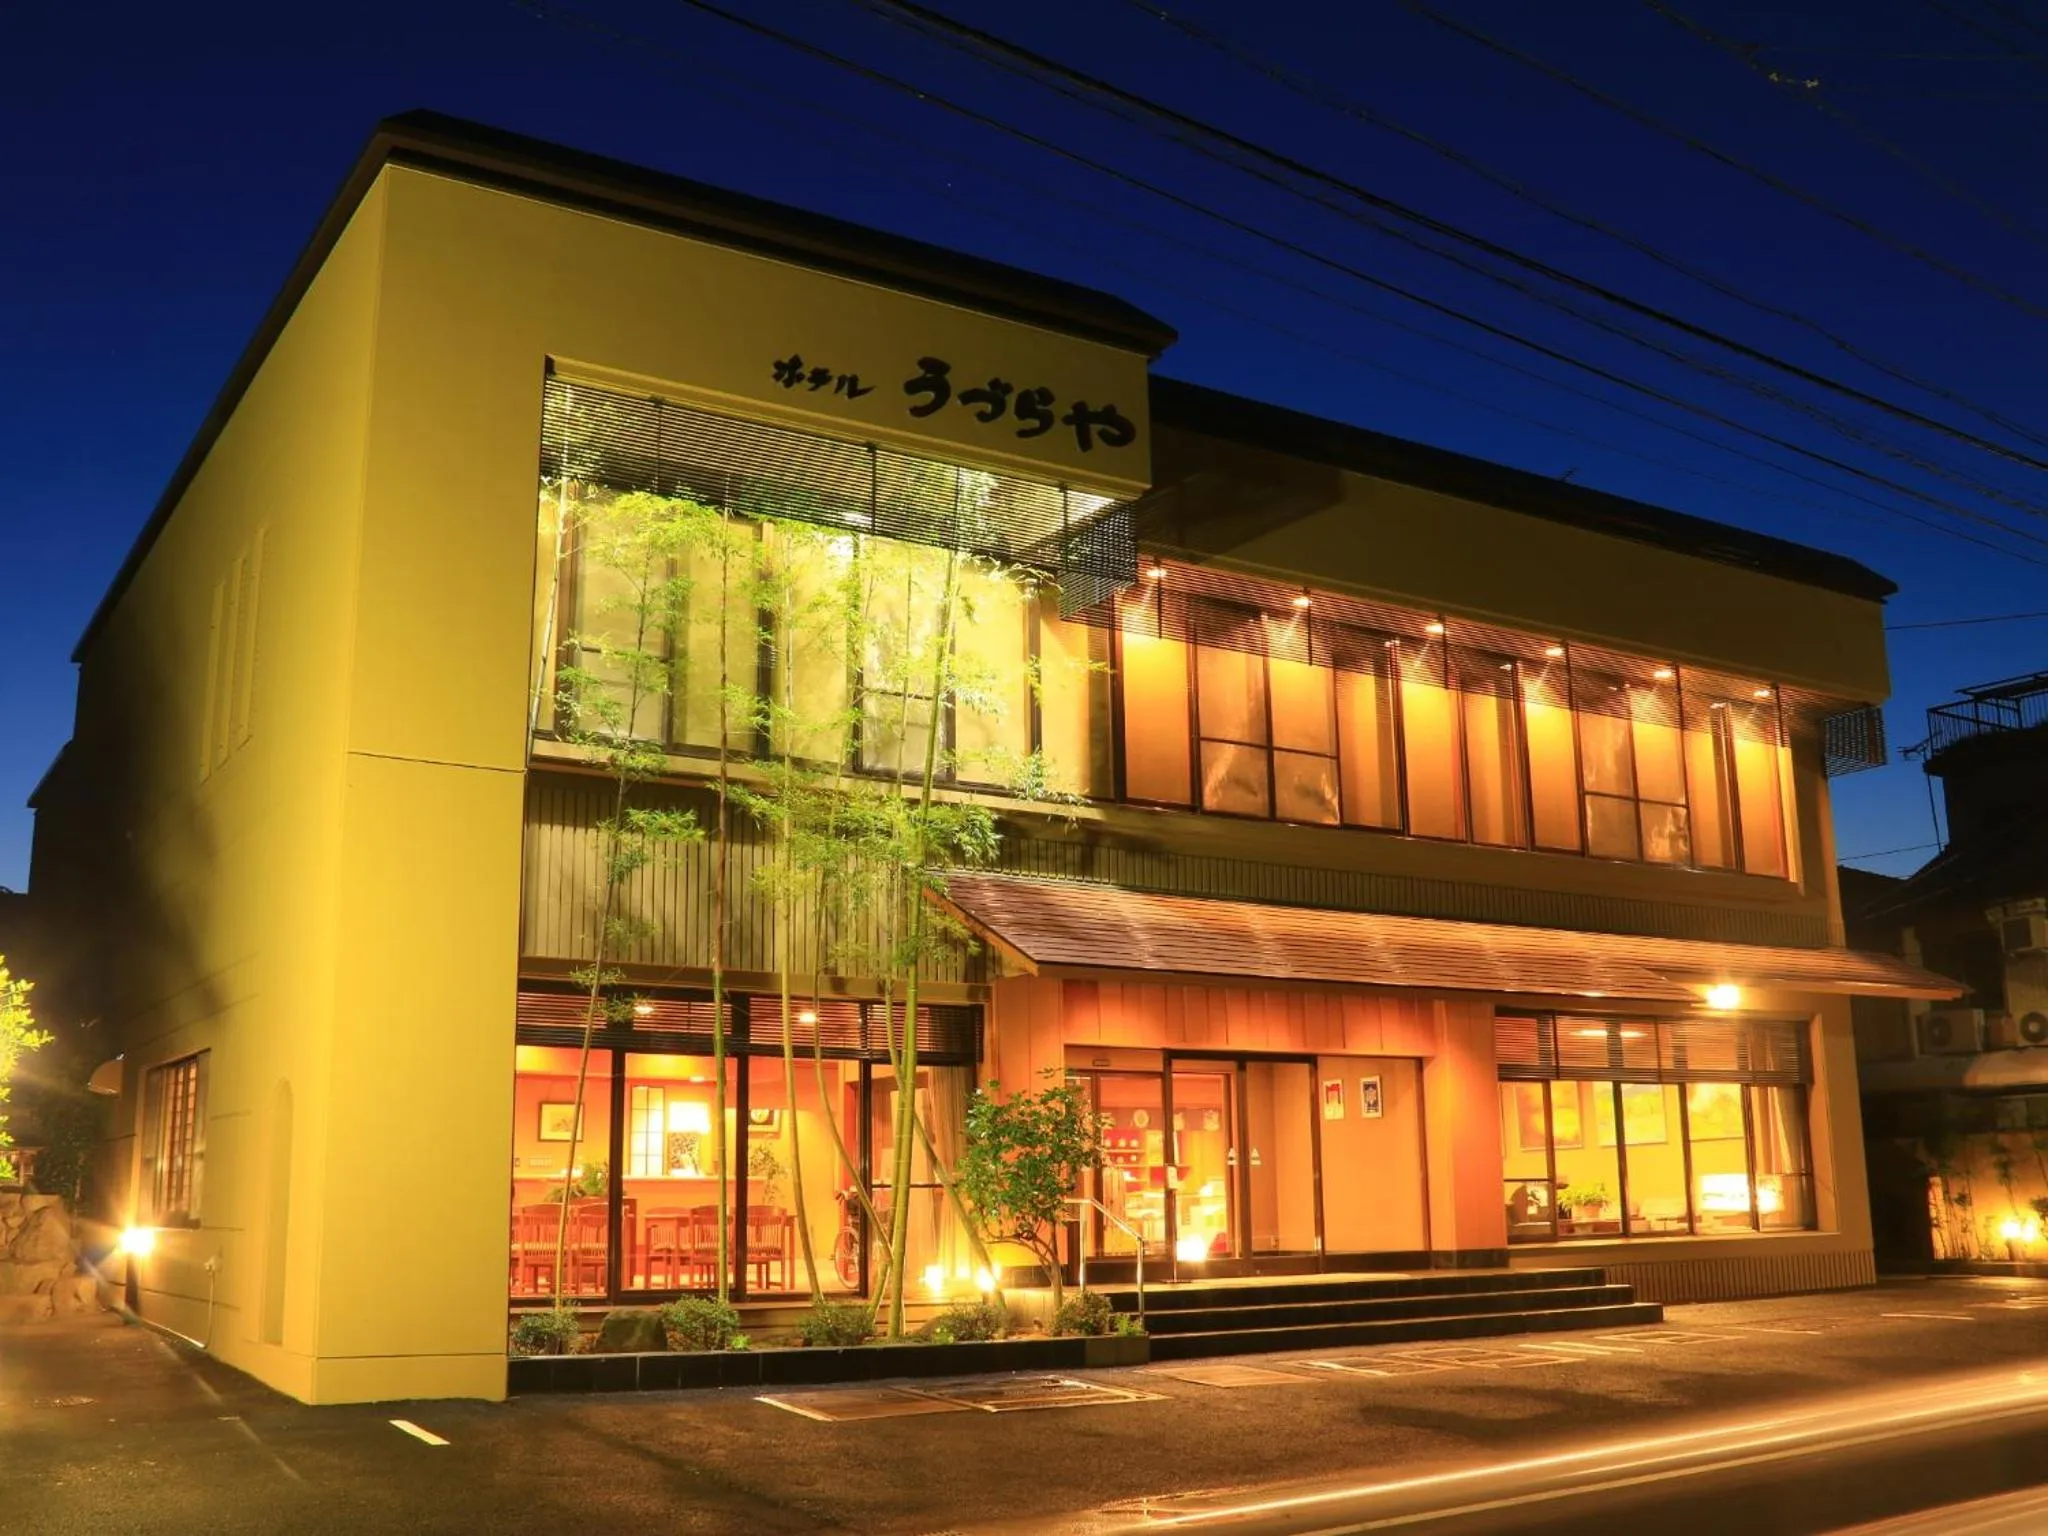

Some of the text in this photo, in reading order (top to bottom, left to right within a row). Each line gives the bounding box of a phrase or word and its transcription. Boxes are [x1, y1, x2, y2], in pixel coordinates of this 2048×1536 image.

[772, 354, 1136, 453] ホテル うづらや
